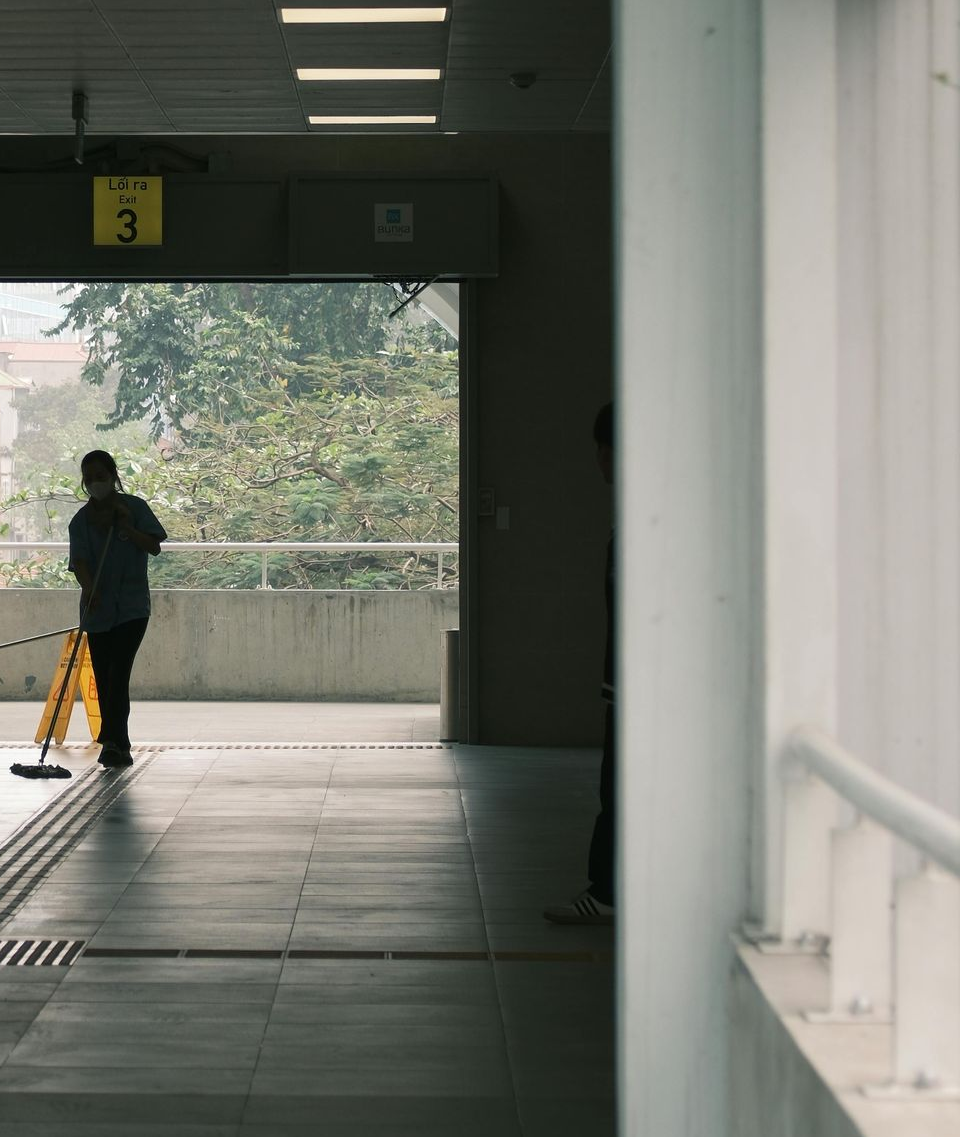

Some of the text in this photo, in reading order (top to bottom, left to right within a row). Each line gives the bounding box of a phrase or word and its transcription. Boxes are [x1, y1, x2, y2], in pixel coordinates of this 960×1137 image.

[109, 175, 147, 190] Lối ra
[119, 195, 136, 204] Exit
[117, 208, 138, 243] 3
